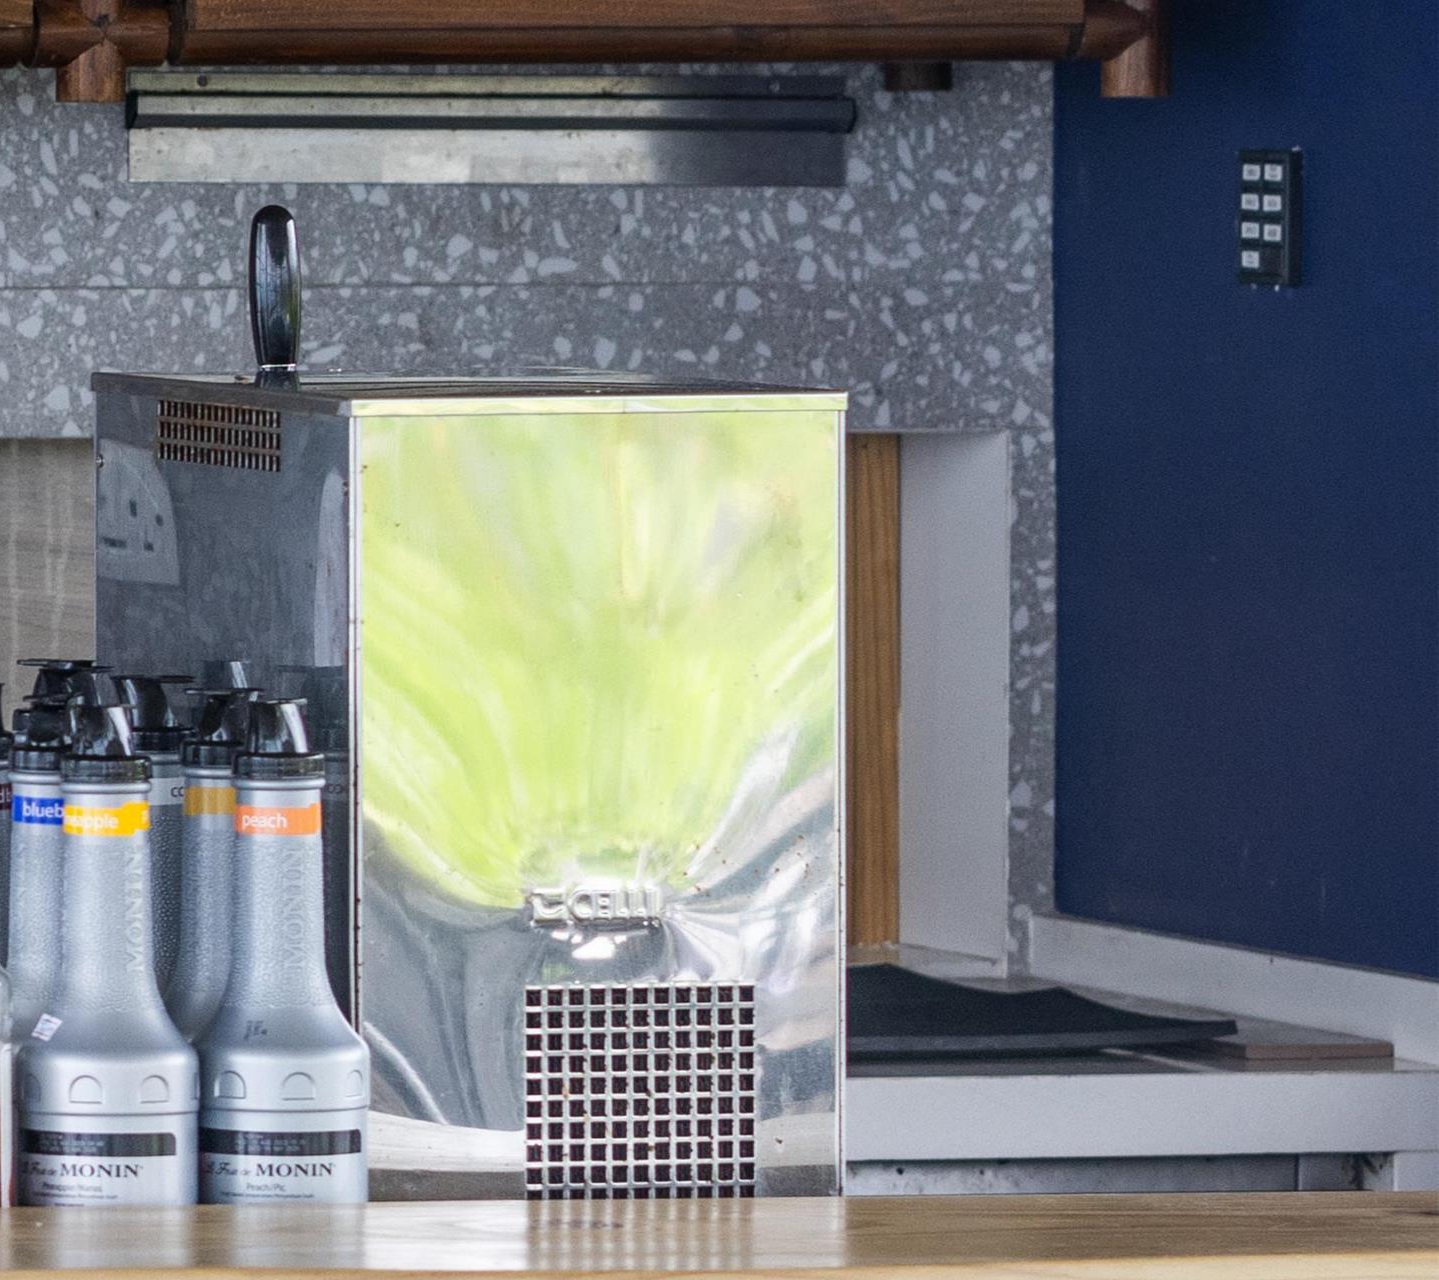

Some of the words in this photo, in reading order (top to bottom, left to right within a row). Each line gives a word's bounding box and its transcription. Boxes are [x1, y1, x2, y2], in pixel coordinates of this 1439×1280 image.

[241, 814, 288, 832] peach
[60, 1163, 139, 1179] MONIN
[256, 1162, 333, 1178] MONIN
